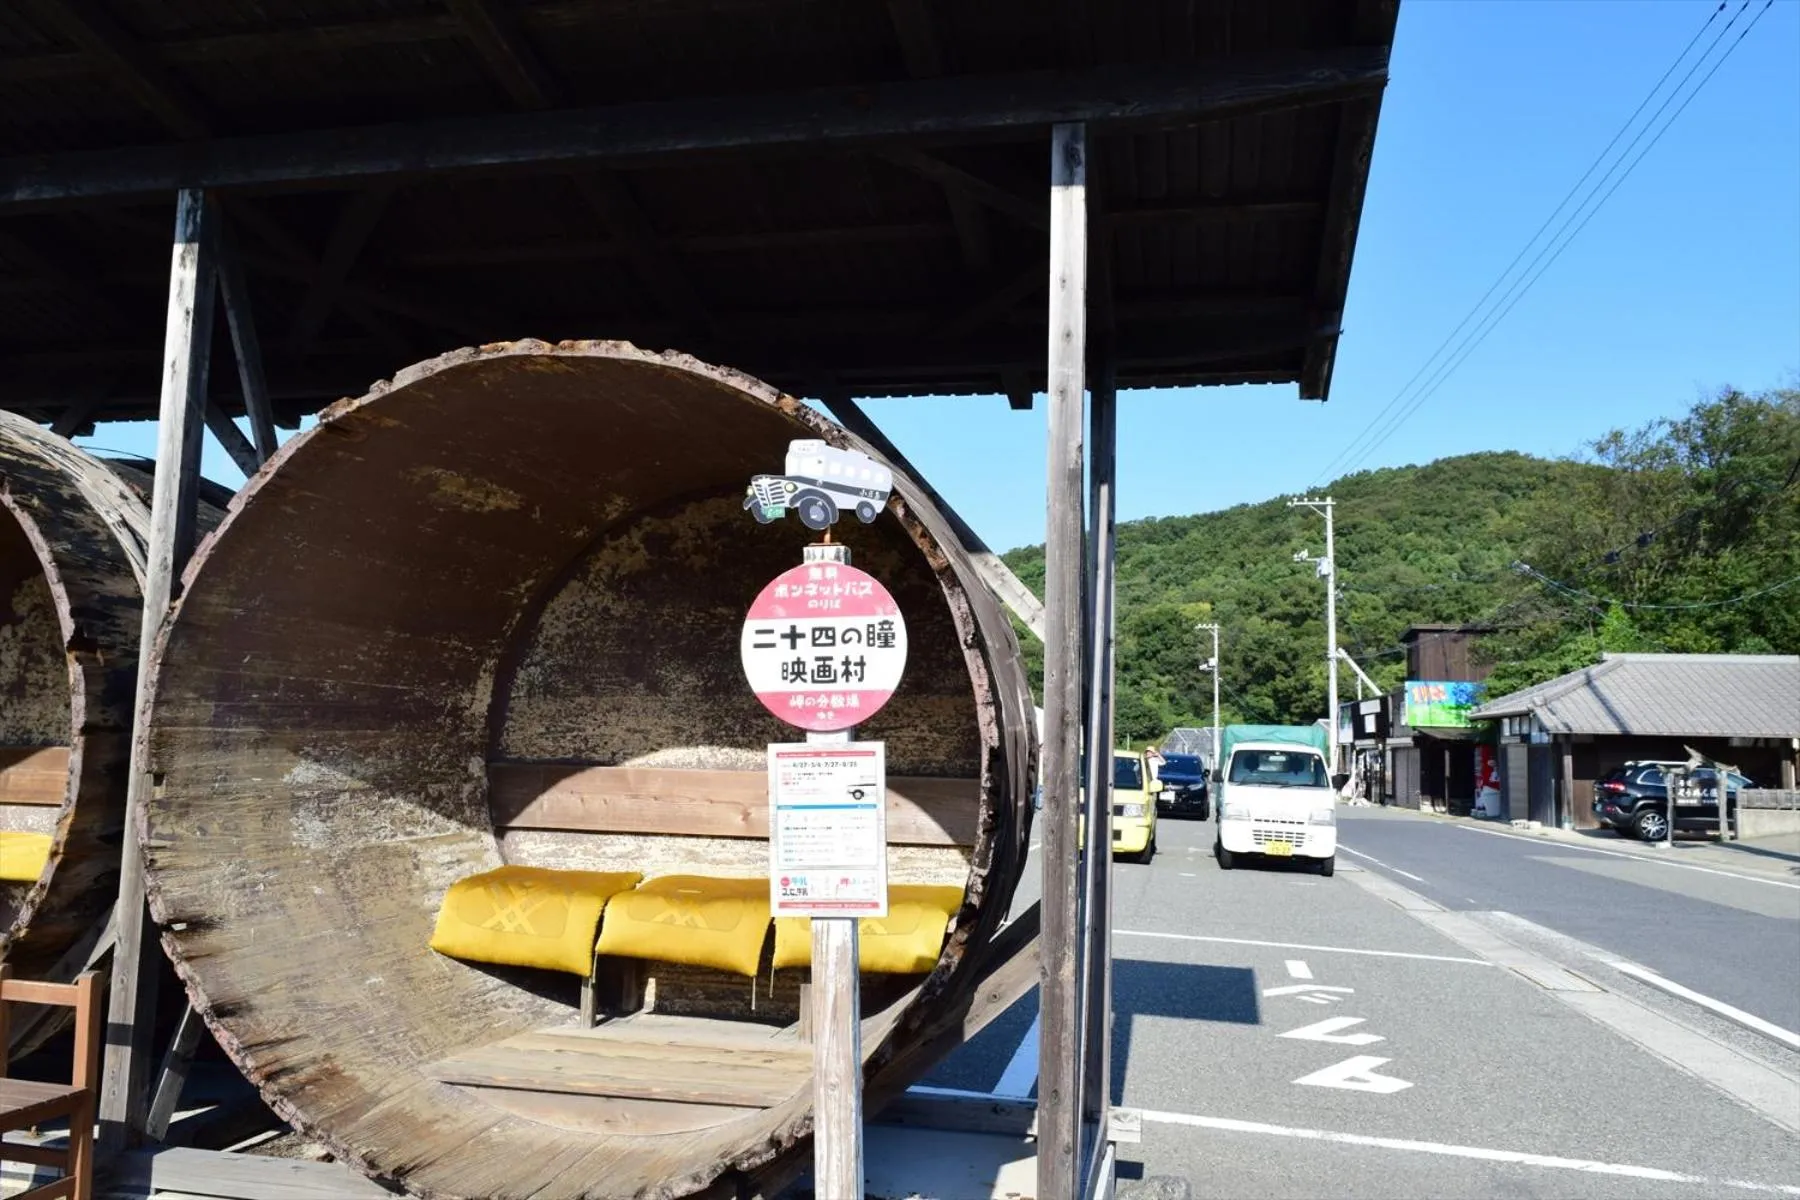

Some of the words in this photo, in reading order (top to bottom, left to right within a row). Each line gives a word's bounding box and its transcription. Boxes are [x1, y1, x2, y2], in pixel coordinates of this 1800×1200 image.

[774, 582, 873, 598] ボンネットバス
[807, 599, 841, 609] のりば
[753, 619, 896, 650] 二十四の瞳
[781, 654, 867, 684] 映画村
[1262, 959, 1415, 1094] タクシー
